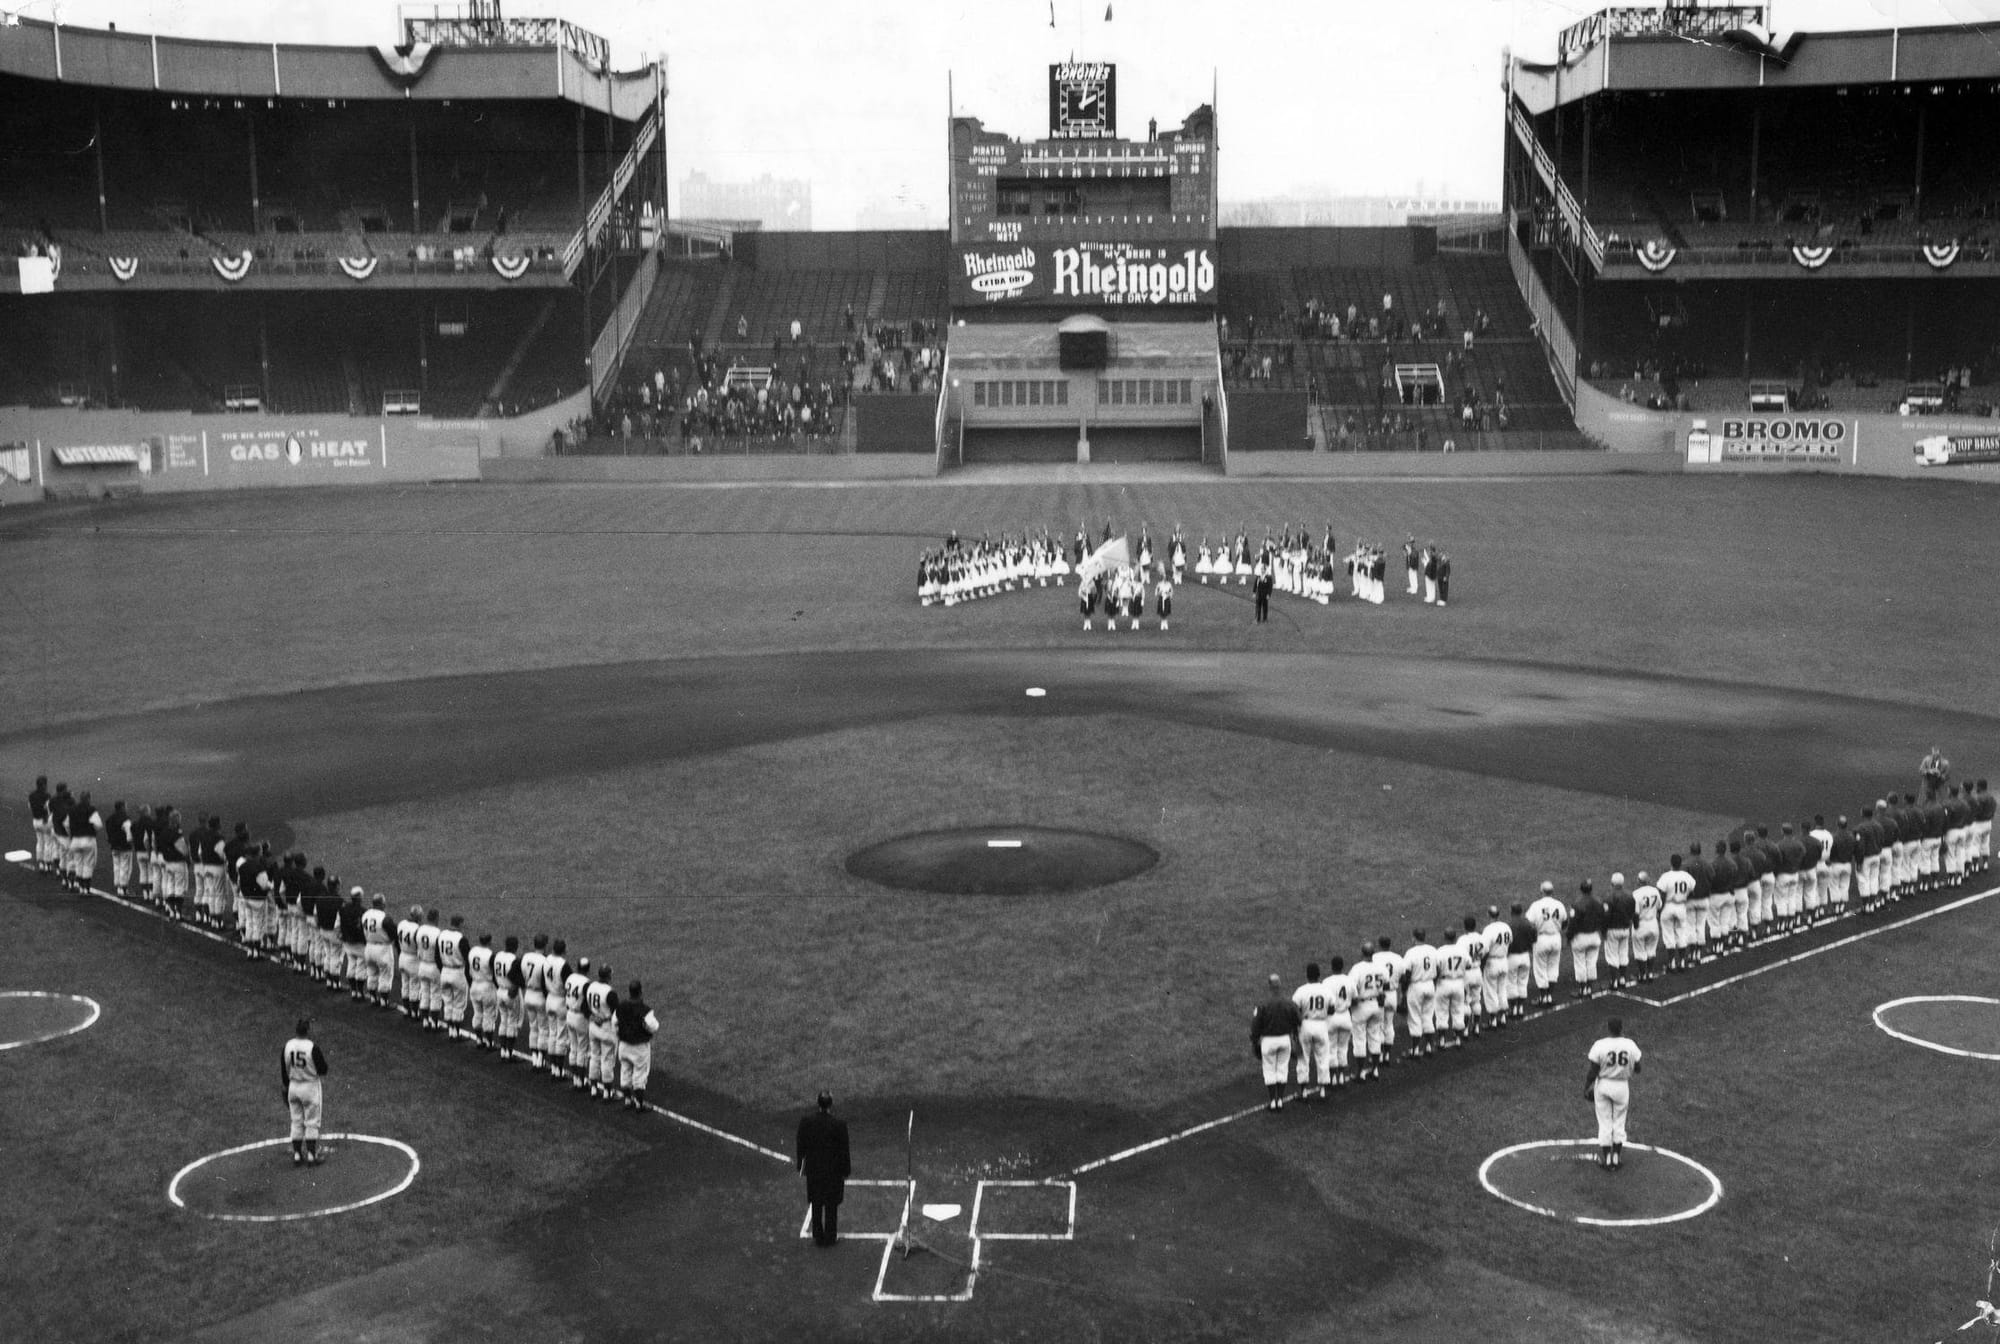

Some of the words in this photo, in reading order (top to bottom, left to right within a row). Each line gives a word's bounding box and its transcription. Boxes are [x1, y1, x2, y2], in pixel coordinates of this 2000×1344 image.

[1055, 66, 1110, 81] LONGINES
[973, 145, 1005, 156] PIRATES
[1174, 143, 1206, 154] UMPIRES
[977, 166, 999, 177] METS
[989, 222, 1022, 233] PIRATES
[996, 232, 1018, 242] METS
[1080, 241, 1114, 251] Millions
[963, 246, 1036, 277] Rheingold
[1053, 246, 1215, 304] Rheingold
[1103, 293, 1123, 304] THE
[1127, 293, 1149, 304] DRY
[1168, 293, 1198, 304] BEER
[222, 432, 238, 441] THE
[241, 431, 255, 440] BIG
[258, 430, 286, 440] SWING
[309, 429, 320, 438] TO
[1723, 418, 1846, 442] BROMO
[230, 443, 280, 461] GAS
[311, 440, 368, 458] HEAT
[1728, 441, 1839, 456] SELTZER
[1957, 438, 1974, 452] TOP
[1975, 436, 2000, 451] BRASS
[56, 445, 138, 465] LISTERINE
[1674, 881, 1687, 895] 10
[1642, 895, 1658, 909] 37
[1542, 907, 1560, 921] 54
[421, 935, 430, 951] 9
[1495, 932, 1511, 945] 48
[441, 940, 454, 956] 12
[473, 956, 481, 972] 6
[495, 962, 507, 977] 21
[527, 963, 535, 979] 7
[1423, 956, 1431, 971] 6
[1447, 956, 1462, 971] 17
[547, 966, 554, 982] 4
[1364, 974, 1384, 990] 25
[566, 982, 579, 1000] 24
[1338, 985, 1347, 1001] 4
[589, 992, 601, 1009] 18
[1309, 995, 1325, 1011] 18
[290, 1051, 307, 1069] 15
[1606, 1050, 1629, 1068] 36
